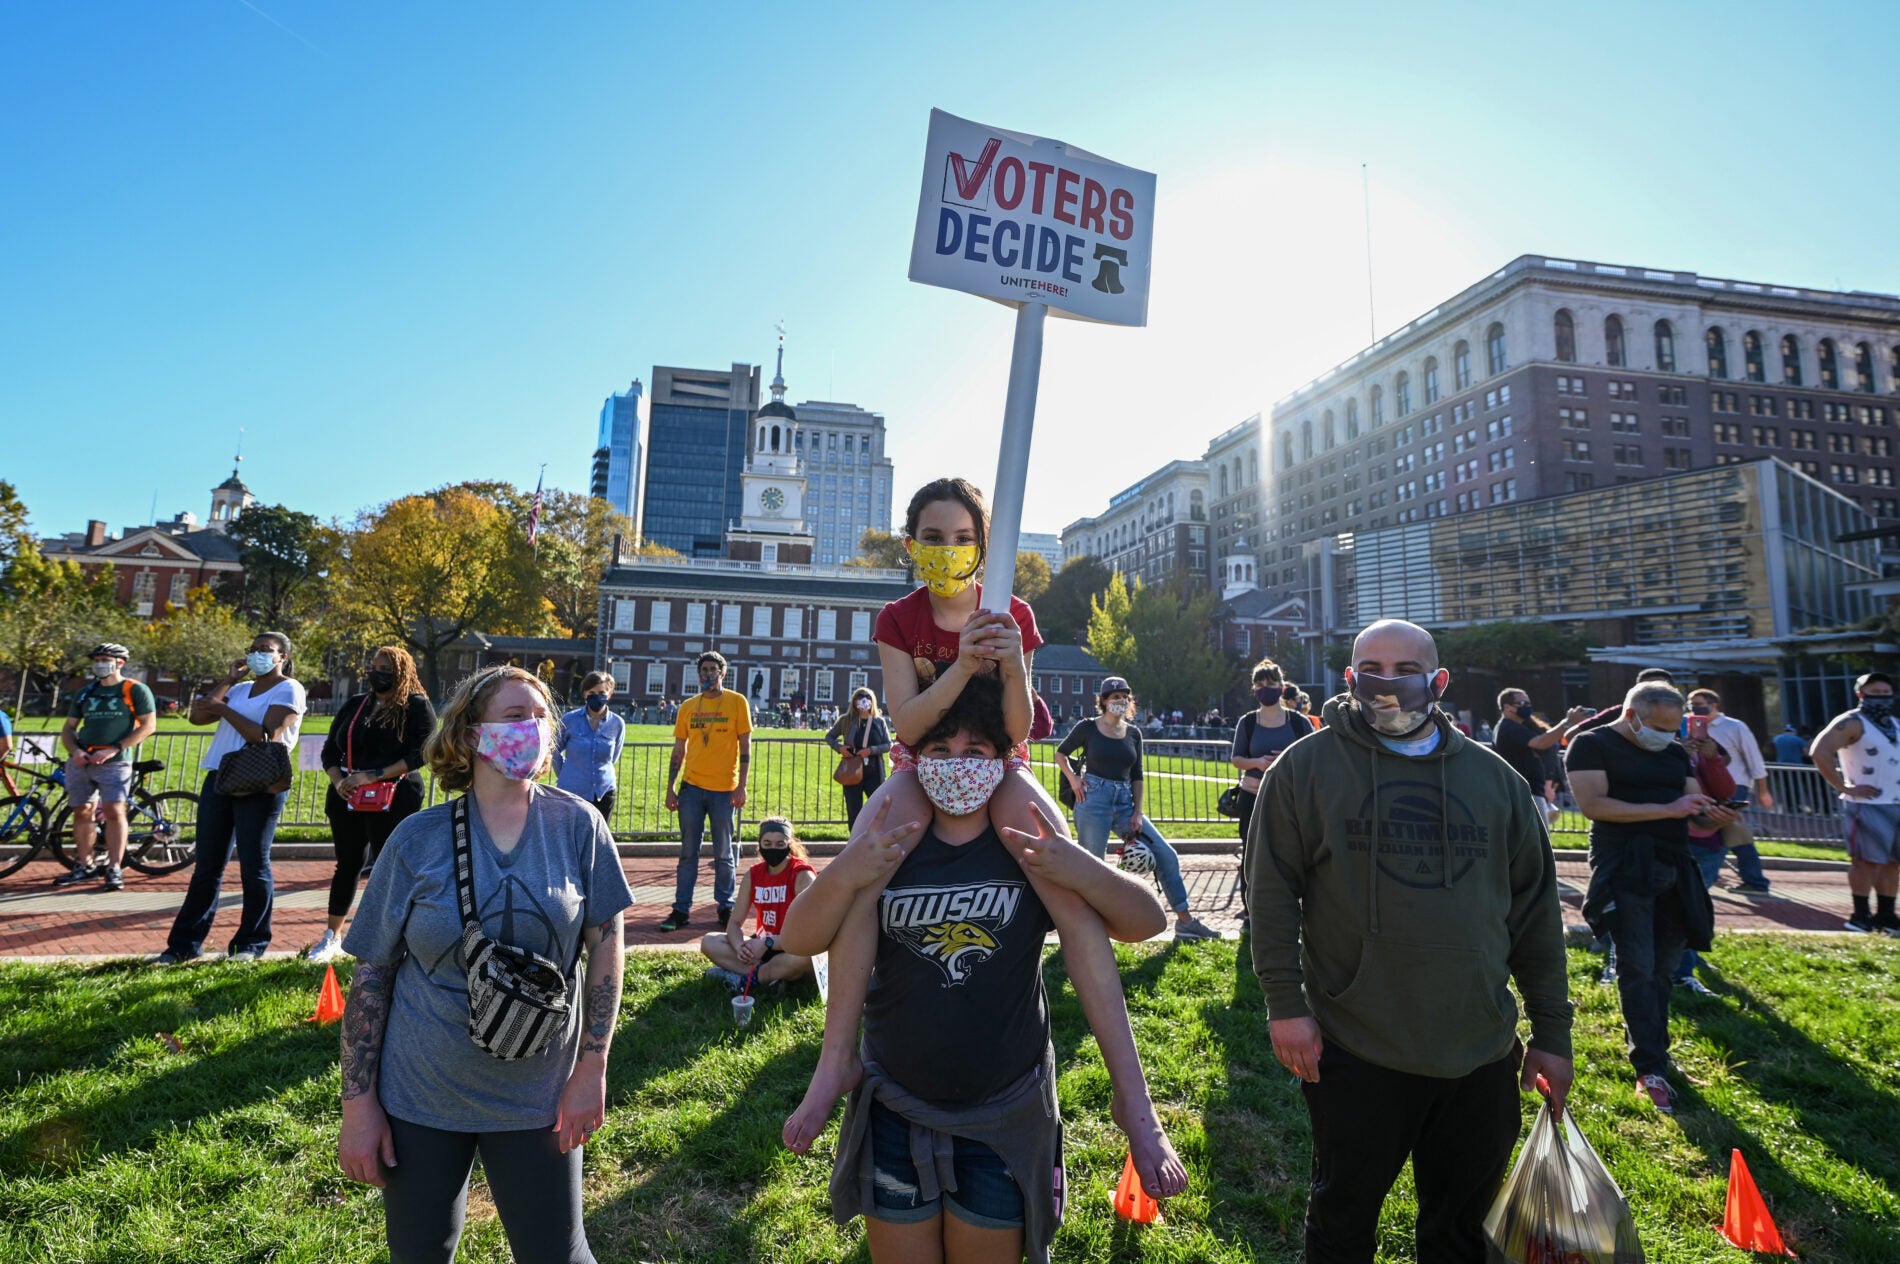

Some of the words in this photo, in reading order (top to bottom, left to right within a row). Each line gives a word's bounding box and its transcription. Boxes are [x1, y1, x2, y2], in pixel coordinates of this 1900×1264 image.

[948, 137, 1134, 241] VOTERS
[935, 206, 1086, 284] DECIDE
[1000, 275, 1068, 298] UNITEHERE!
[1344, 818, 1489, 844] BALTIMORE
[880, 881, 1026, 934] TOWSON
